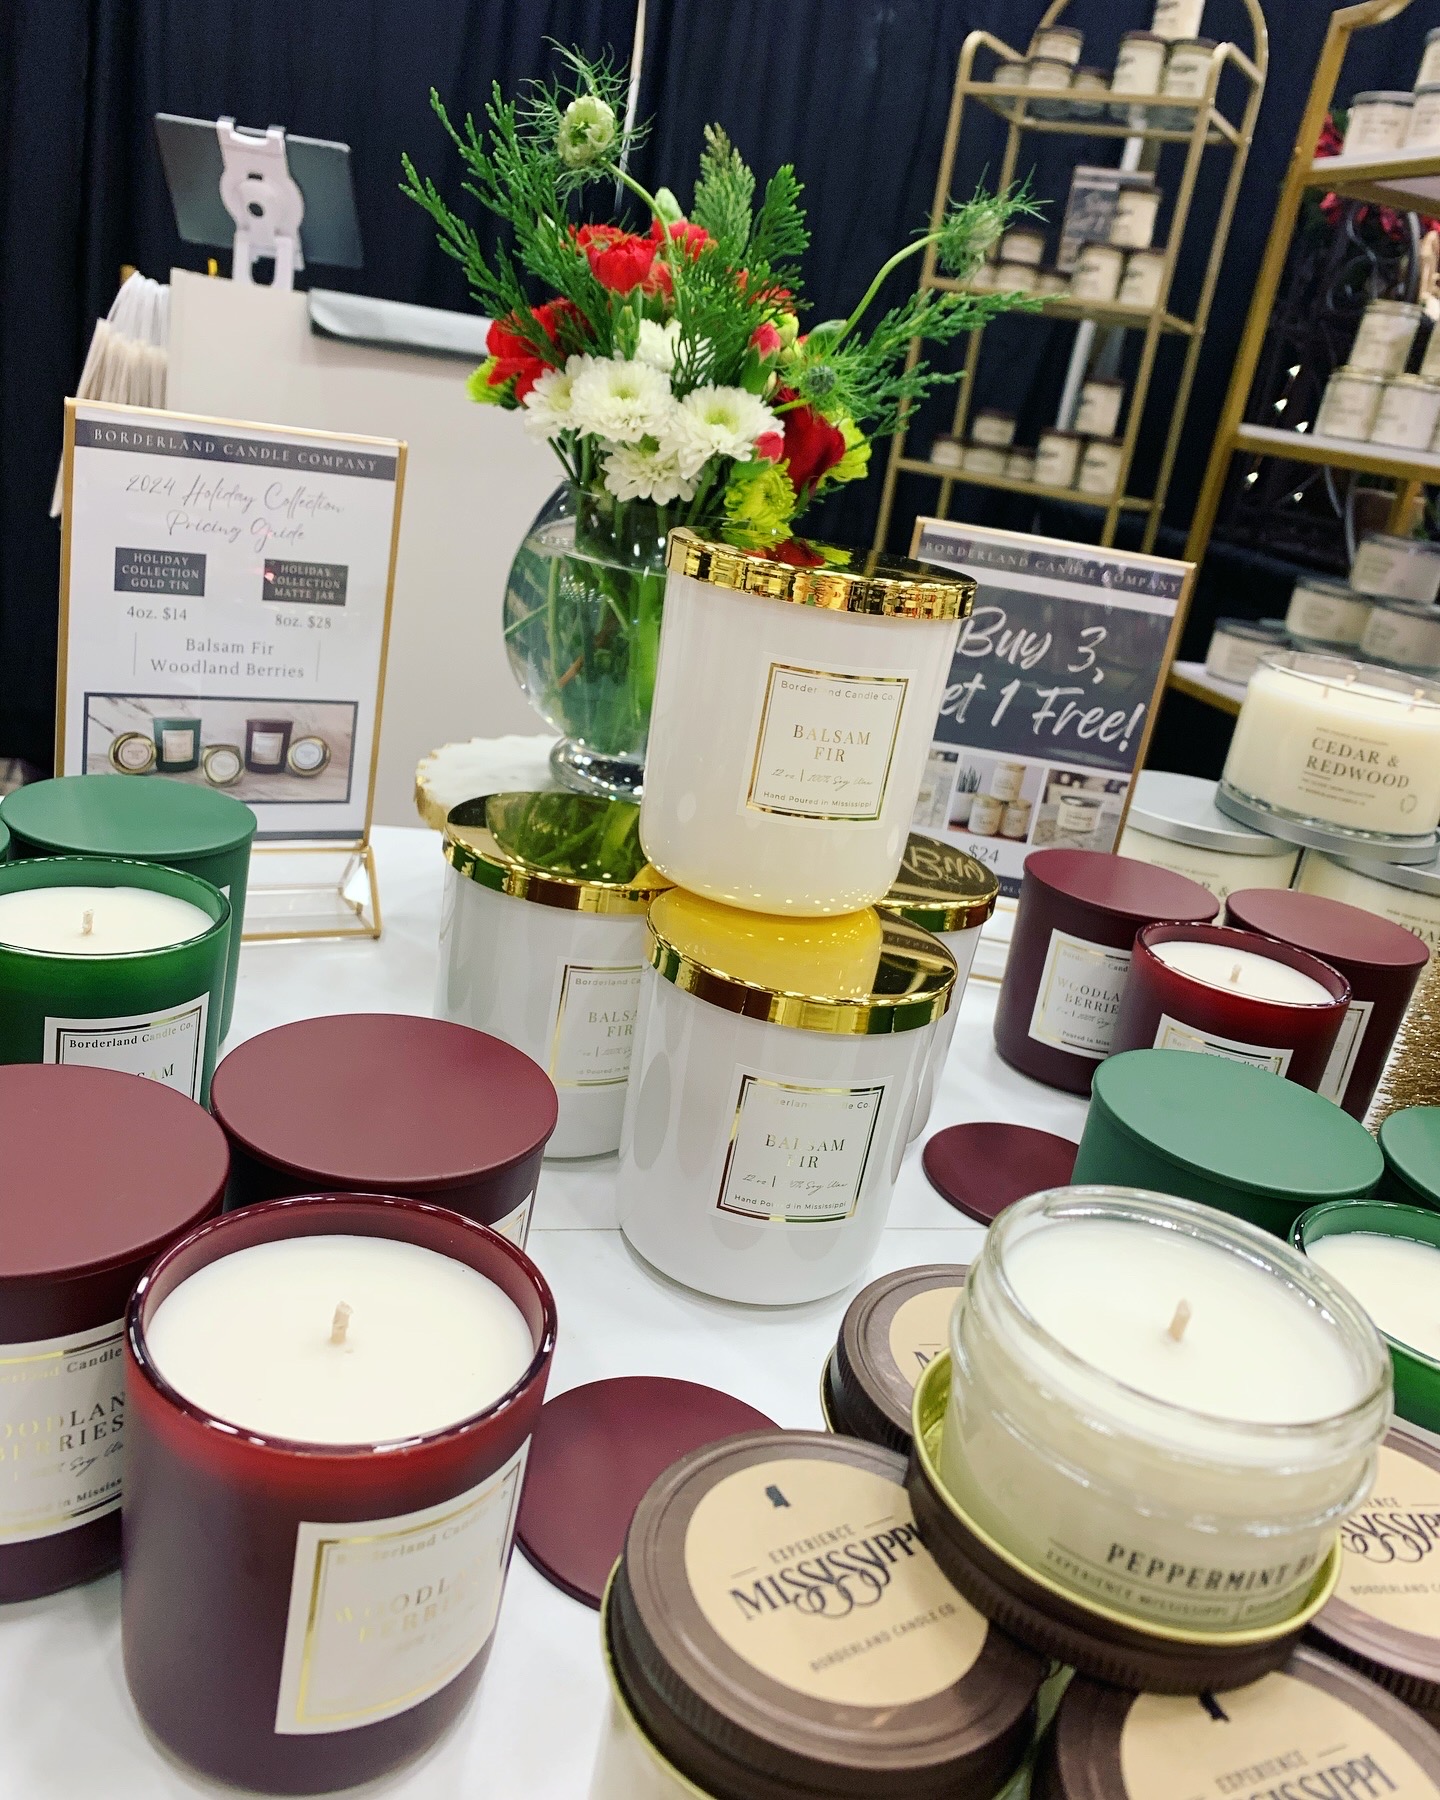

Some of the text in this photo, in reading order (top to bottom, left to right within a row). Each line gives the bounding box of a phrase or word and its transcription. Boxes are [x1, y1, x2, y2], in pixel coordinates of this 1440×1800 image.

[94, 428, 377, 472] BORDERLAND CANDLE COMPANY
[126, 473, 344, 519] 2024 Holiday Collection
[167, 509, 241, 544] Pricing
[134, 553, 189, 566] HOLIDAY
[924, 542, 1029, 568] BORDERLAND
[1035, 560, 1096, 579] CANDLE
[122, 564, 199, 579] COLLECTION
[281, 564, 332, 577] HOLIDAY
[131, 578, 190, 590] GOLD TIN
[274, 587, 312, 599] MATTE
[126, 606, 187, 621] 4oz. $14
[275, 614, 331, 629] 8oz. $28
[185, 637, 275, 655] Balsam Fir
[956, 606, 1107, 684] Buy 3,
[151, 659, 304, 678] Woodland Berries
[845, 690, 879, 701] Candle
[939, 672, 1146, 752] et 1 Free!
[793, 724, 871, 745] BALSAM
[814, 746, 845, 762] FIR
[1312, 737, 1400, 769] CEDAR &
[1306, 755, 1410, 789] REDWOOD
[763, 791, 786, 801] Hand
[788, 795, 819, 806] Poured
[831, 800, 872, 809] Mississippi
[69, 1022, 194, 1049] Borderland Candle Co.
[607, 1024, 633, 1038] FIR
[734, 1194, 758, 1205] Hand
[793, 1202, 802, 1210] in
[804, 1201, 847, 1211] Mississippi
[66, 1347, 123, 1374] Candle
[768, 1523, 857, 1564] EXPERIENCE
[1107, 1543, 1289, 1592] PEPPERMINT
[809, 1630, 892, 1673] BORDERLAND
[892, 1610, 939, 1637] CANDLE
[1215, 1749, 1309, 1795] EXPERIENCE
